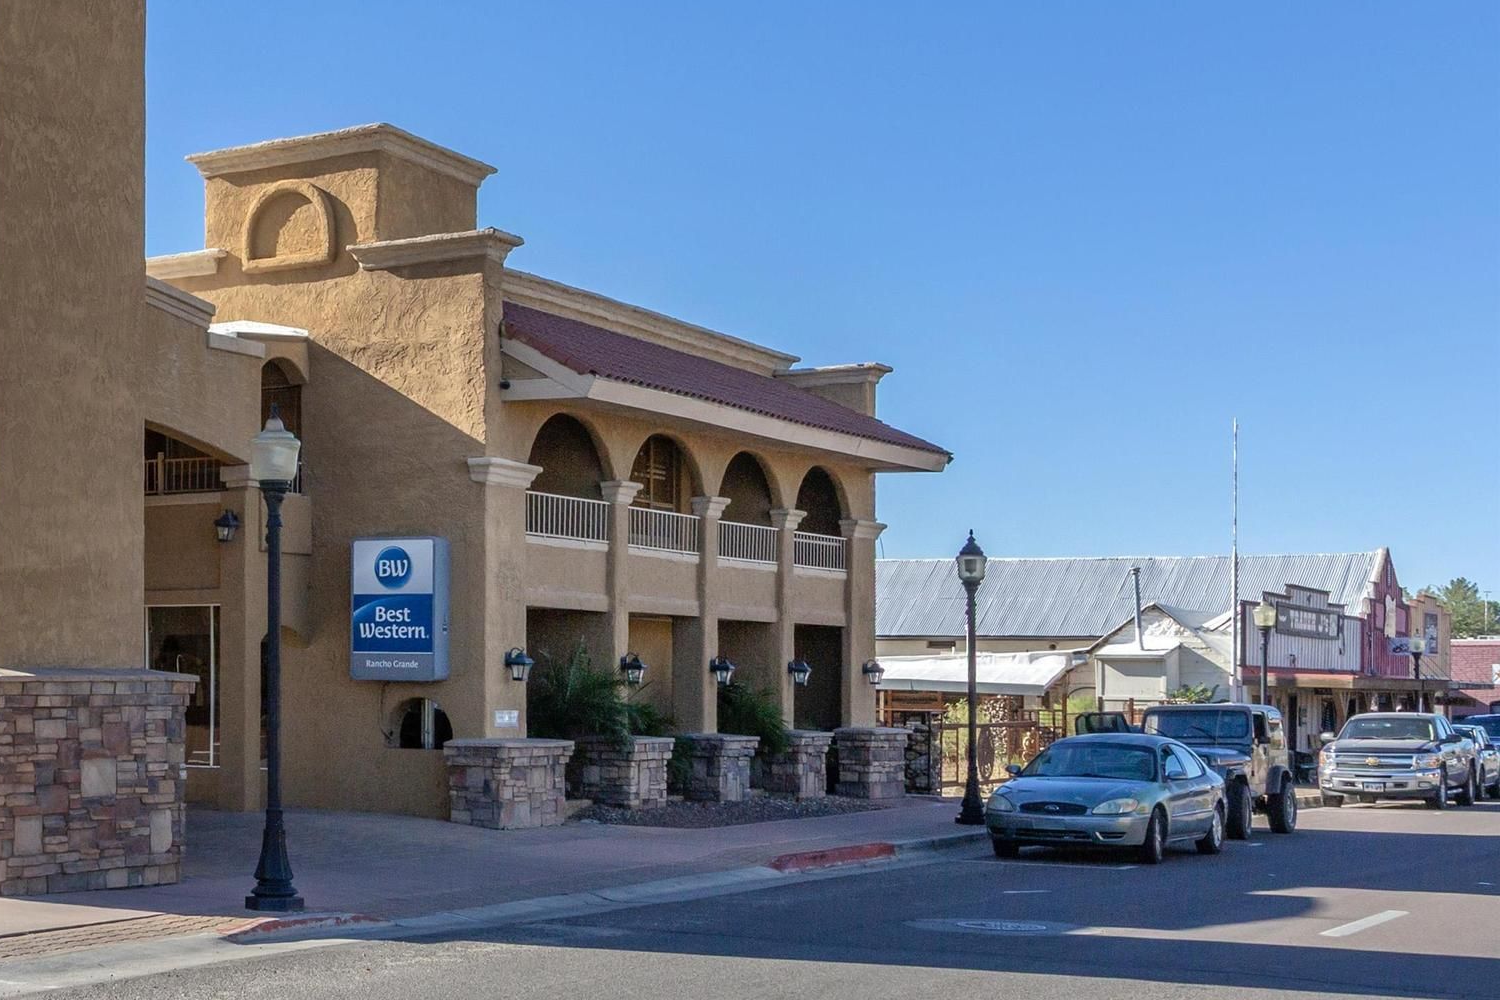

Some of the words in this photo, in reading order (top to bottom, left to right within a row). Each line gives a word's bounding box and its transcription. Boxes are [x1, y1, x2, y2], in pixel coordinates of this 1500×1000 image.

[378, 559, 408, 577] BW
[375, 606, 411, 622] Best
[366, 659, 392, 668] Rancho
[393, 660, 419, 669] Grande
